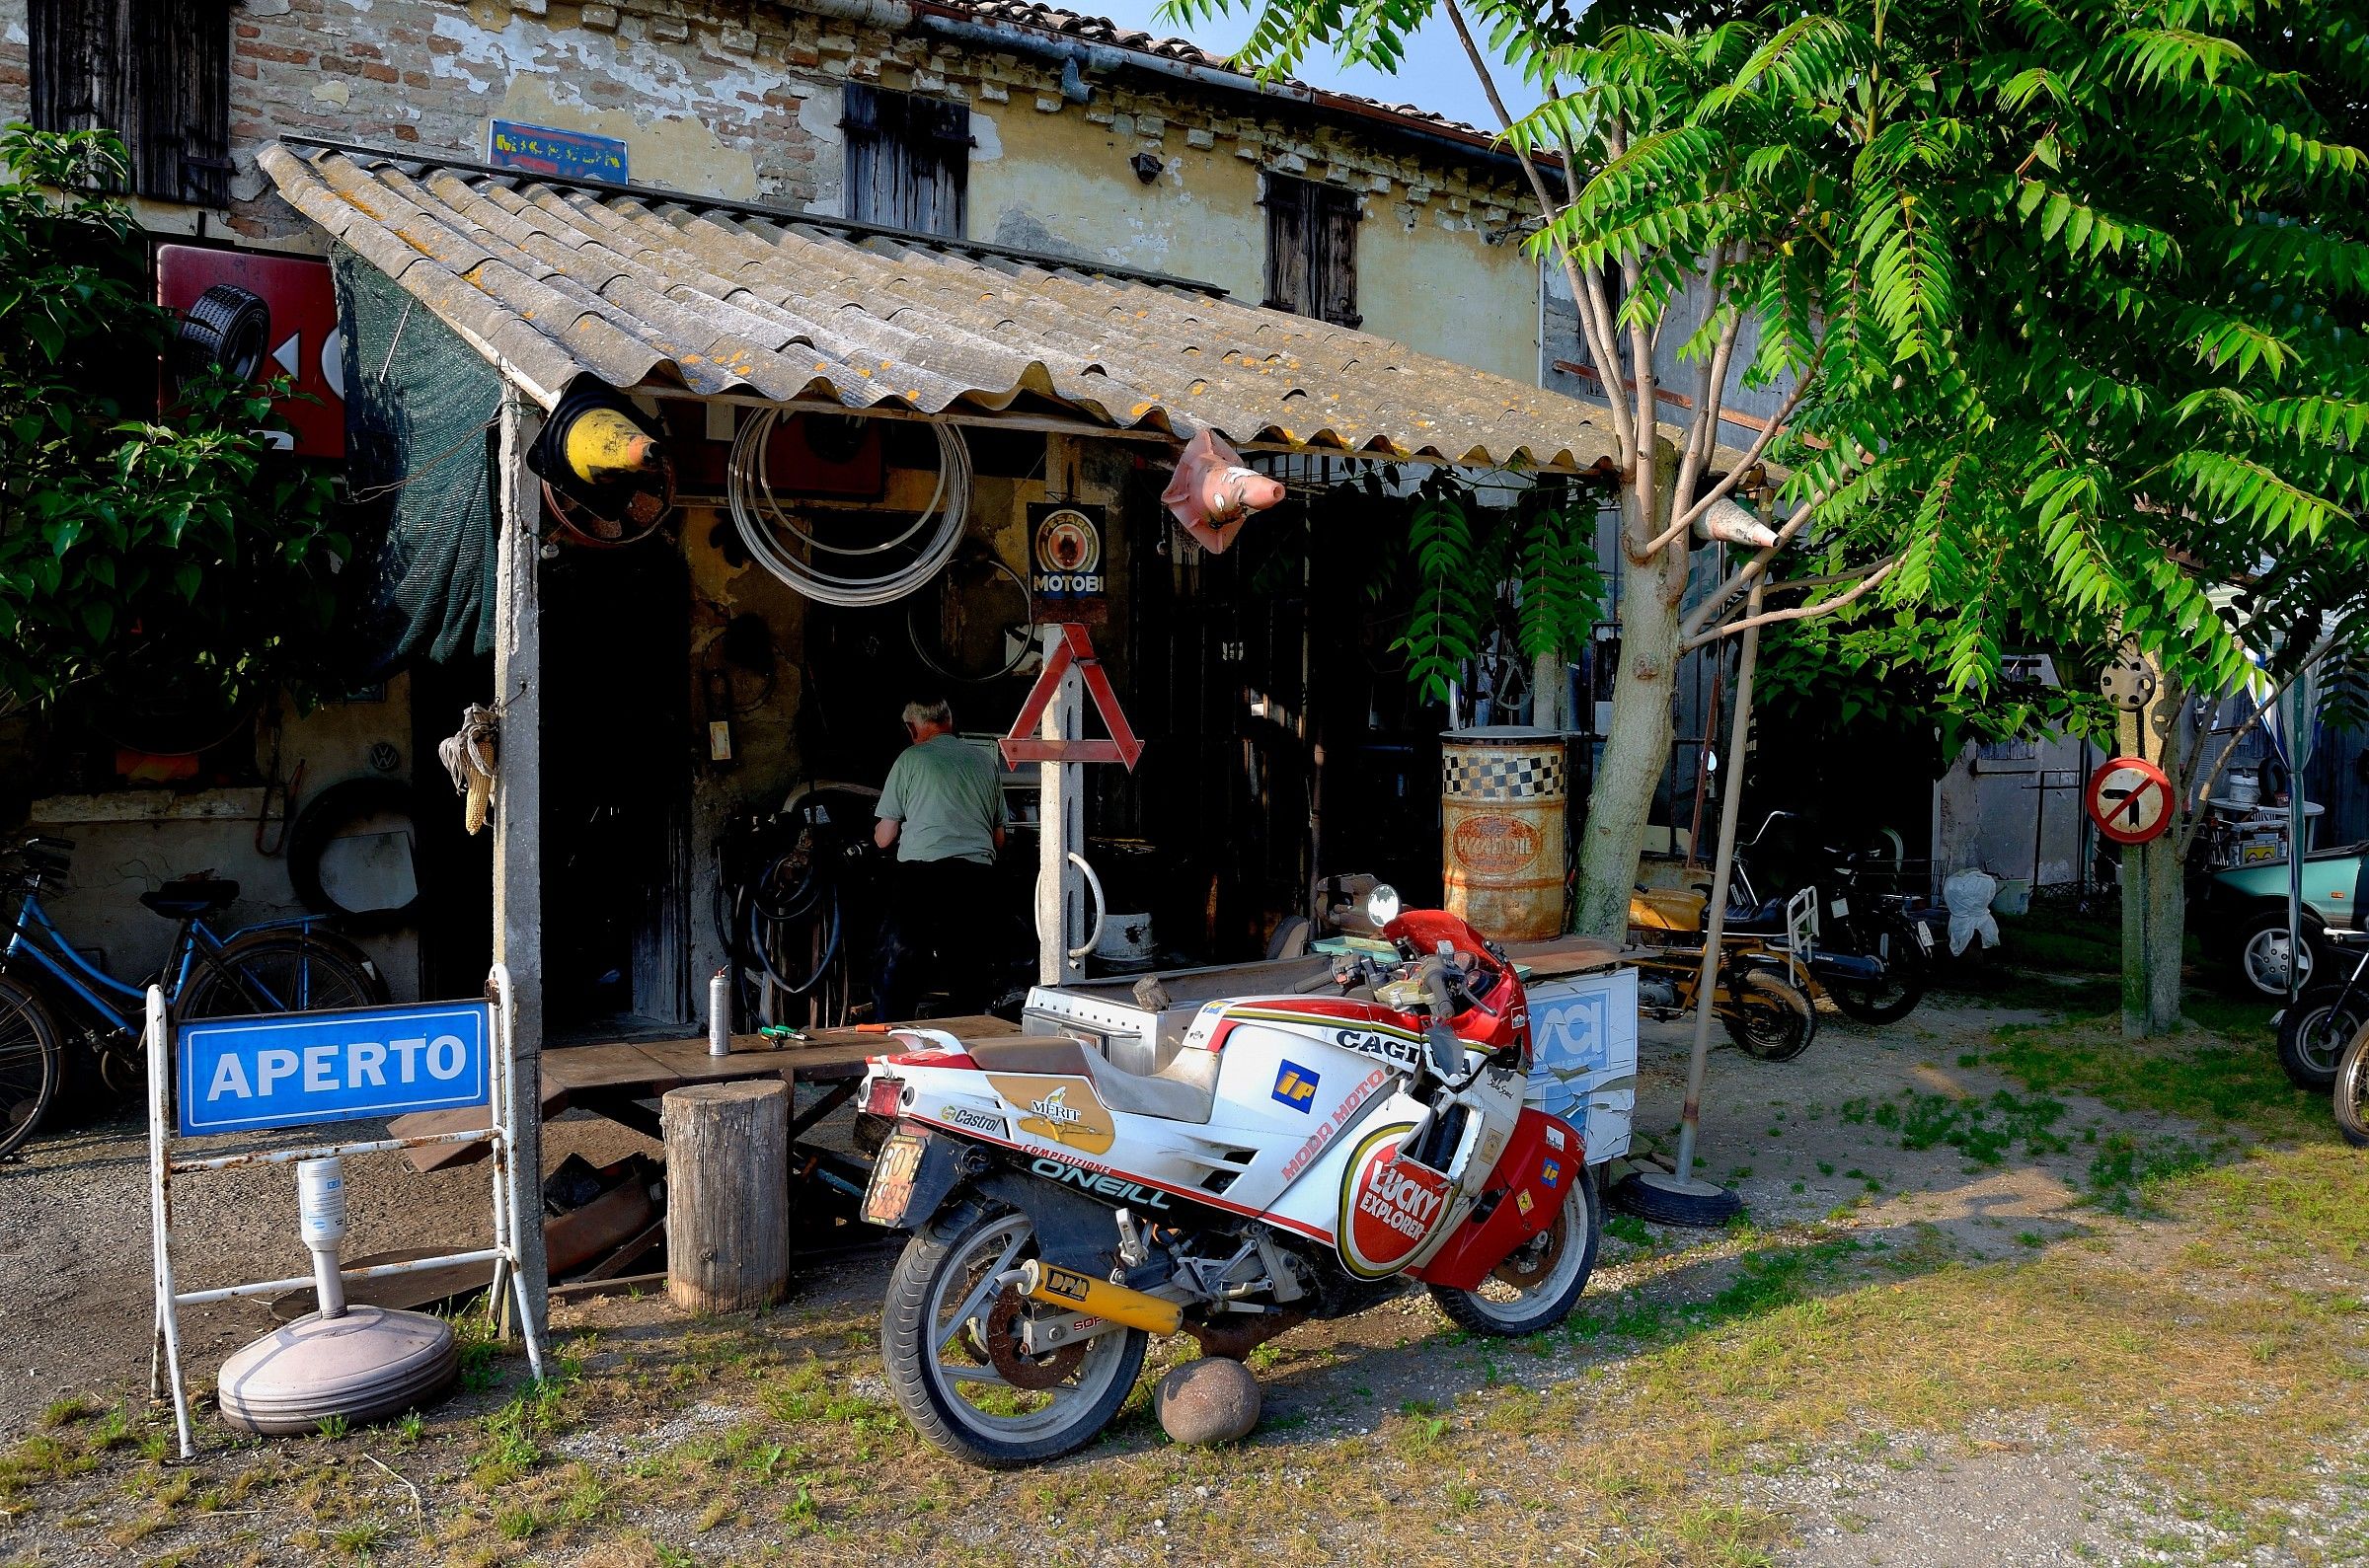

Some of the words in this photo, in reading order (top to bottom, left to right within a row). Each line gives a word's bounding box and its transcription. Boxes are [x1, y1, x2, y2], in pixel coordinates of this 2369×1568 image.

[1033, 575, 1105, 592] MOTOBI
[1337, 1031, 1472, 1076] CAGIA
[1532, 1001, 1602, 1062] ACI
[207, 1033, 467, 1102] APERTO
[955, 1109, 1001, 1132] Castrol
[1032, 1101, 1081, 1121] MERIT
[1281, 1122, 1334, 1181] MODA
[1333, 1069, 1385, 1126] MOTO
[1021, 1144, 1111, 1173] COMPETIZIONE
[1032, 1157, 1171, 1210] O'NEILL
[1368, 1159, 1442, 1221] LUCKY
[1359, 1191, 1425, 1241] EXPLORER
